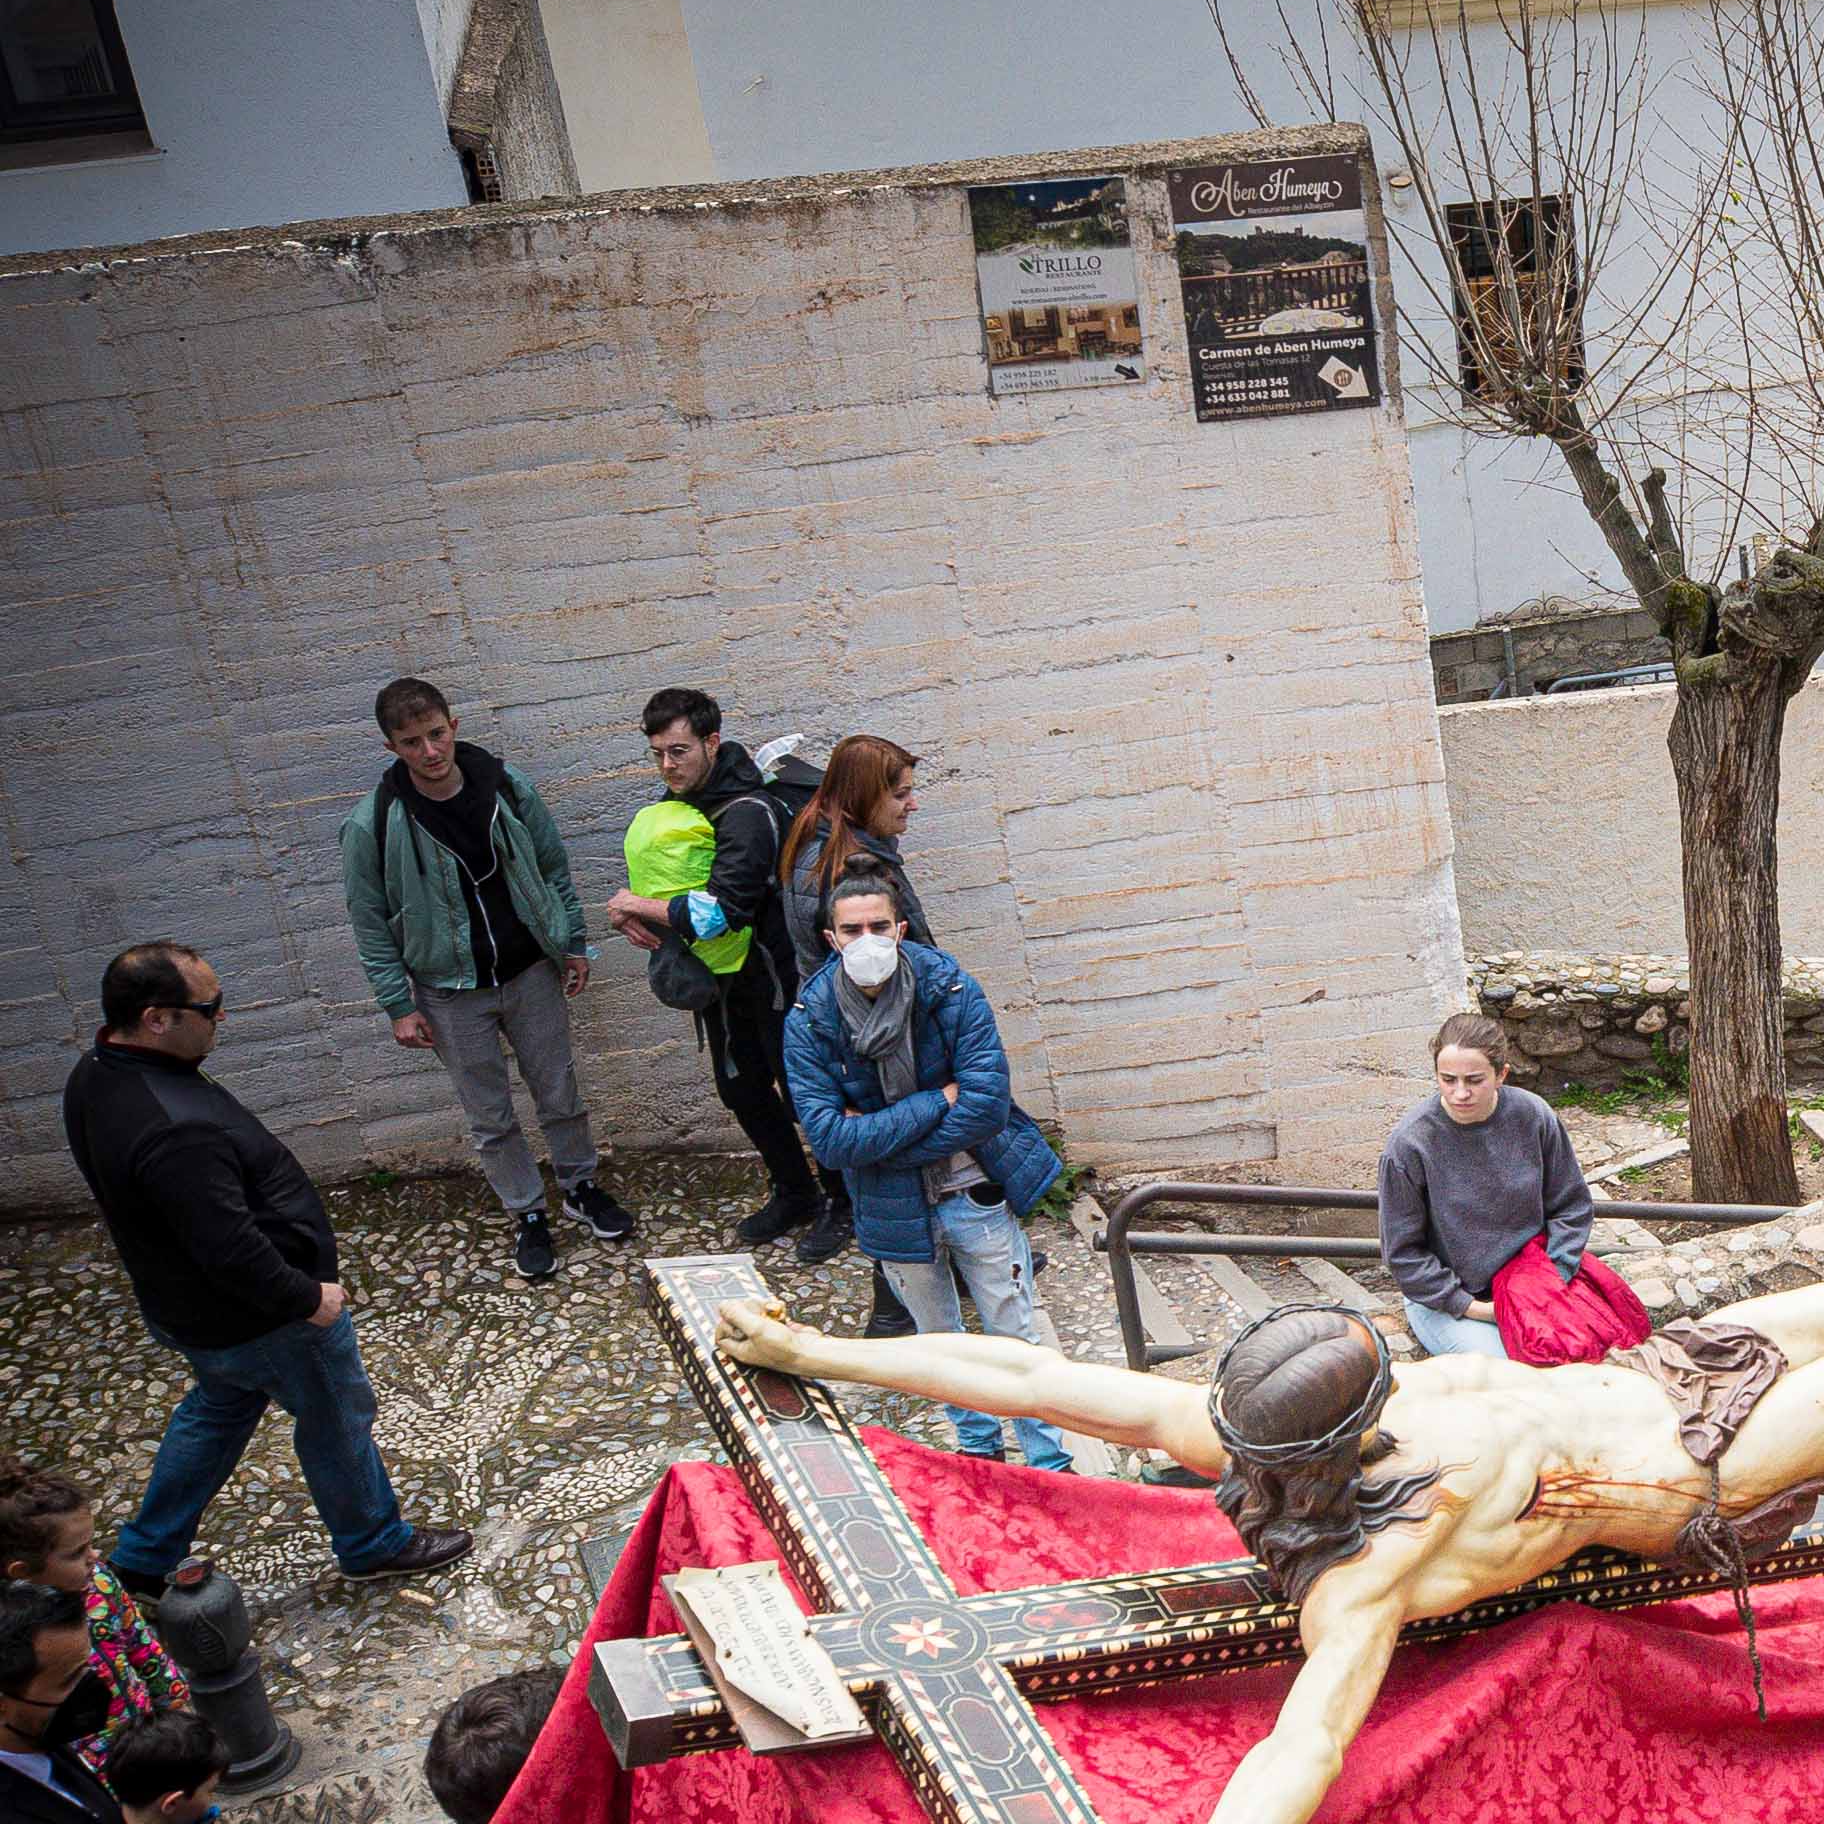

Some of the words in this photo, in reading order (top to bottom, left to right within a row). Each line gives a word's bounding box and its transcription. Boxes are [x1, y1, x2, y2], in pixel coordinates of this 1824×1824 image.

[1191, 168, 1259, 217] Aben
[1260, 167, 1342, 202] Humeya
[1034, 255, 1102, 273] TRILLO
[1045, 270, 1102, 279] RESTAURANTE
[1199, 346, 1252, 360] Carmen
[1254, 344, 1271, 356] de
[1274, 341, 1308, 354] Aben
[1311, 337, 1366, 352] Humeya
[1201, 362, 1232, 372] Cuesta
[1233, 360, 1246, 368] de
[1301, 353, 1311, 363] 12
[1204, 380, 1225, 393] +34
[1226, 379, 1246, 390] 958
[1247, 378, 1268, 389] 228
[1269, 377, 1289, 387] 345
[1205, 393, 1225, 405] +34
[1228, 392, 1247, 403] 633
[1248, 391, 1269, 401] 042
[1271, 389, 1290, 399] 881
[1207, 399, 1326, 415] www.abenhumeya.com
